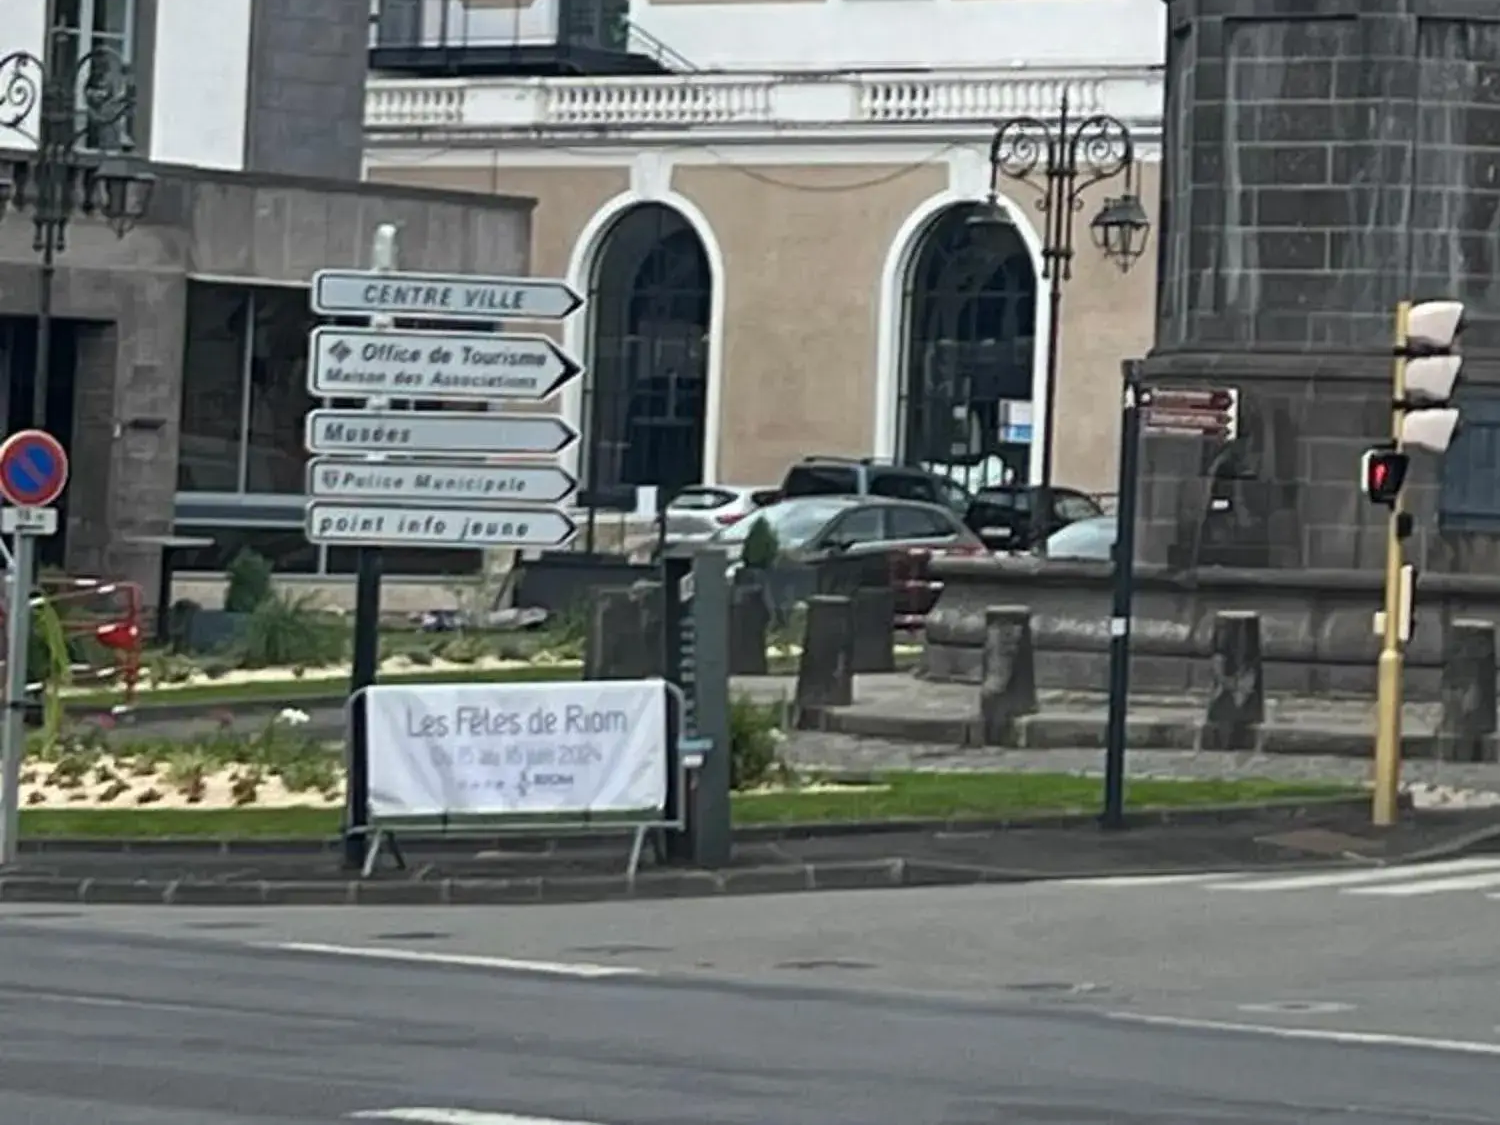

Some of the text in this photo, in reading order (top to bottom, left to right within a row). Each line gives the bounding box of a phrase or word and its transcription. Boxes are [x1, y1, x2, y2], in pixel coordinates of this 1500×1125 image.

[362, 283, 528, 310] CENTRE VILLE
[361, 342, 548, 367] Office de Tourisme
[325, 368, 538, 389] Maison des Associations
[323, 422, 411, 444] Musées
[341, 471, 527, 494] Police Municipale
[318, 515, 530, 540] point info jeune
[406, 704, 629, 738] Les Fêtes de Riom
